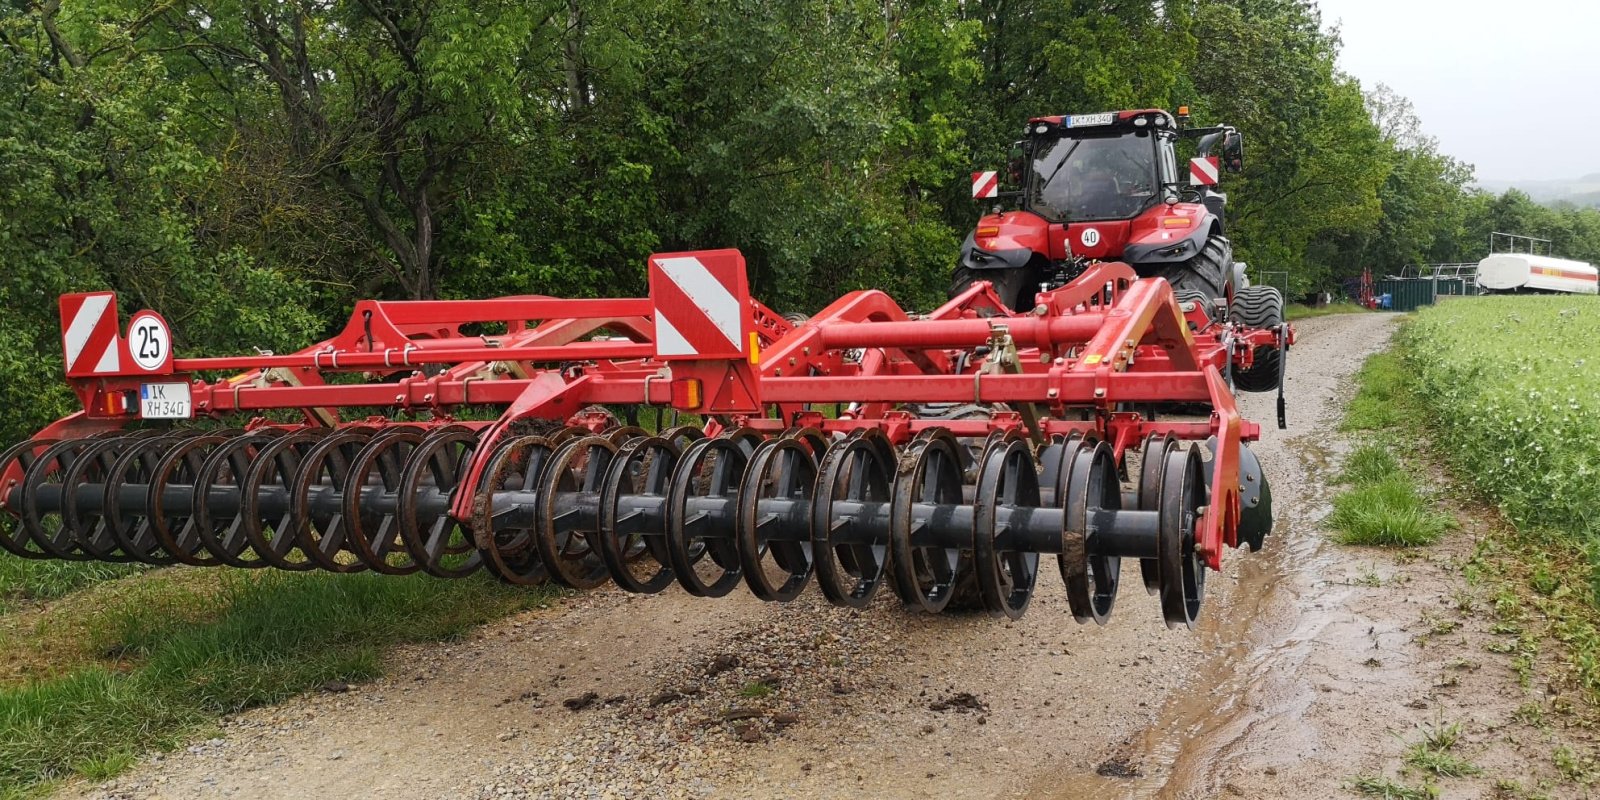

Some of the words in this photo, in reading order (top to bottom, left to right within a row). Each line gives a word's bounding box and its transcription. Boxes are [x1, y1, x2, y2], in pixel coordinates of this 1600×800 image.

[1086, 115, 1095, 123] XH
[1097, 114, 1112, 123] 340
[1084, 231, 1096, 243] 40
[138, 326, 160, 359] 25
[147, 401, 161, 416] XH
[163, 401, 184, 416] 340
